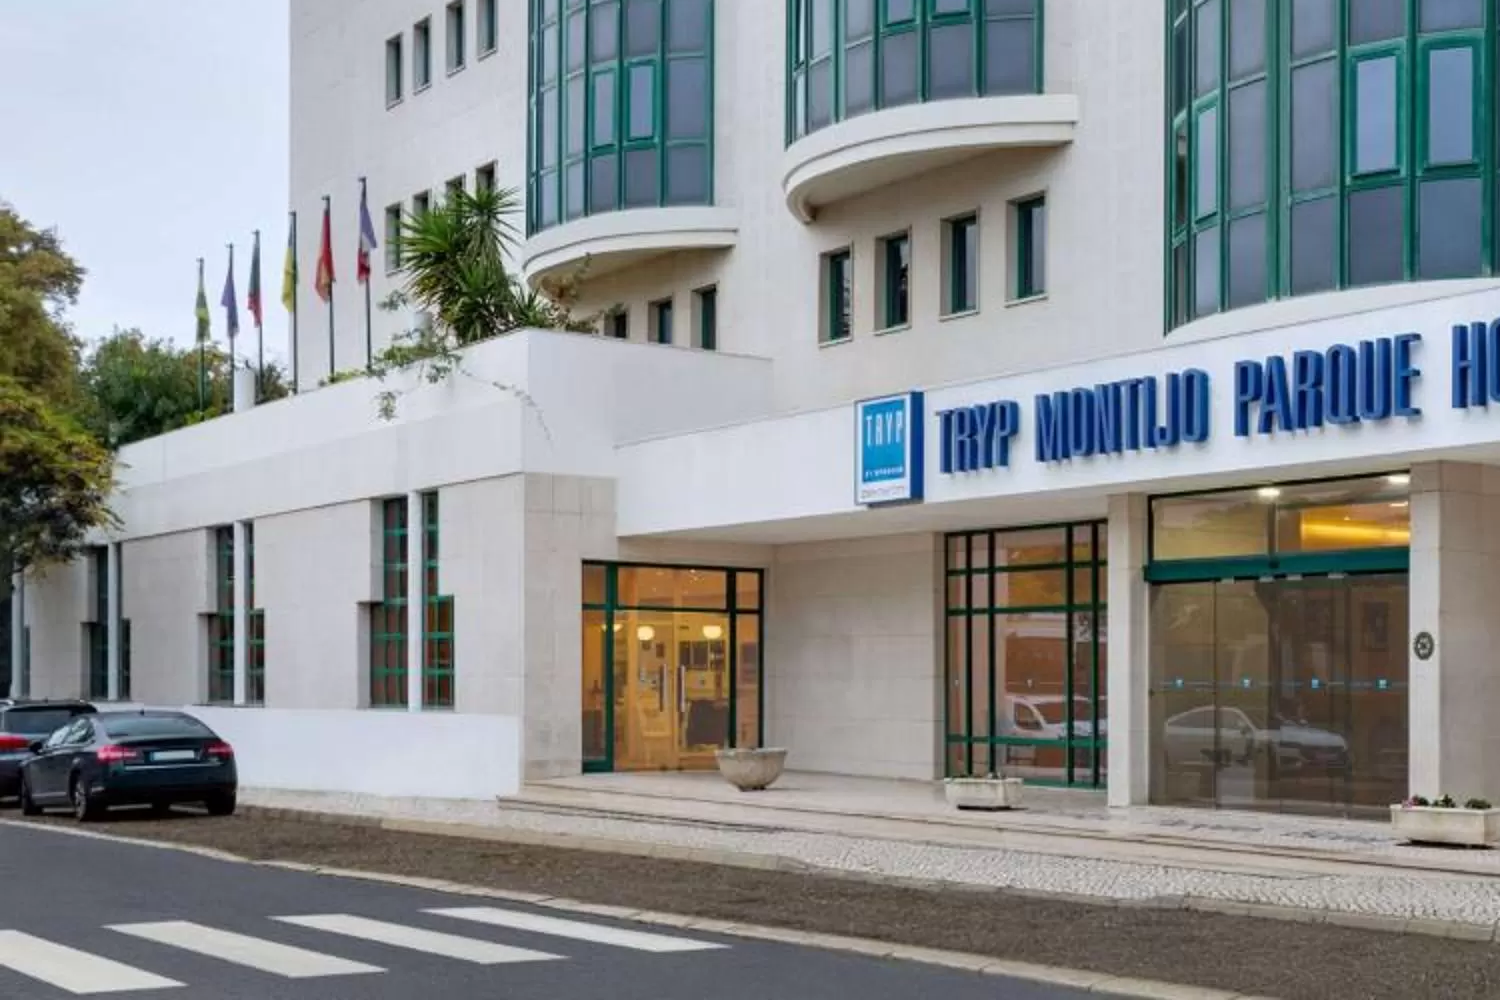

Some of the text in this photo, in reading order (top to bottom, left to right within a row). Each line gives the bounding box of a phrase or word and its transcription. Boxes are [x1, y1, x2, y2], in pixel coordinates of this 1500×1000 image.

[866, 410, 903, 446] TRYP
[935, 400, 1019, 474] TRYP
[1034, 368, 1210, 462] MONTIJO
[1234, 332, 1422, 437] PARQUE
